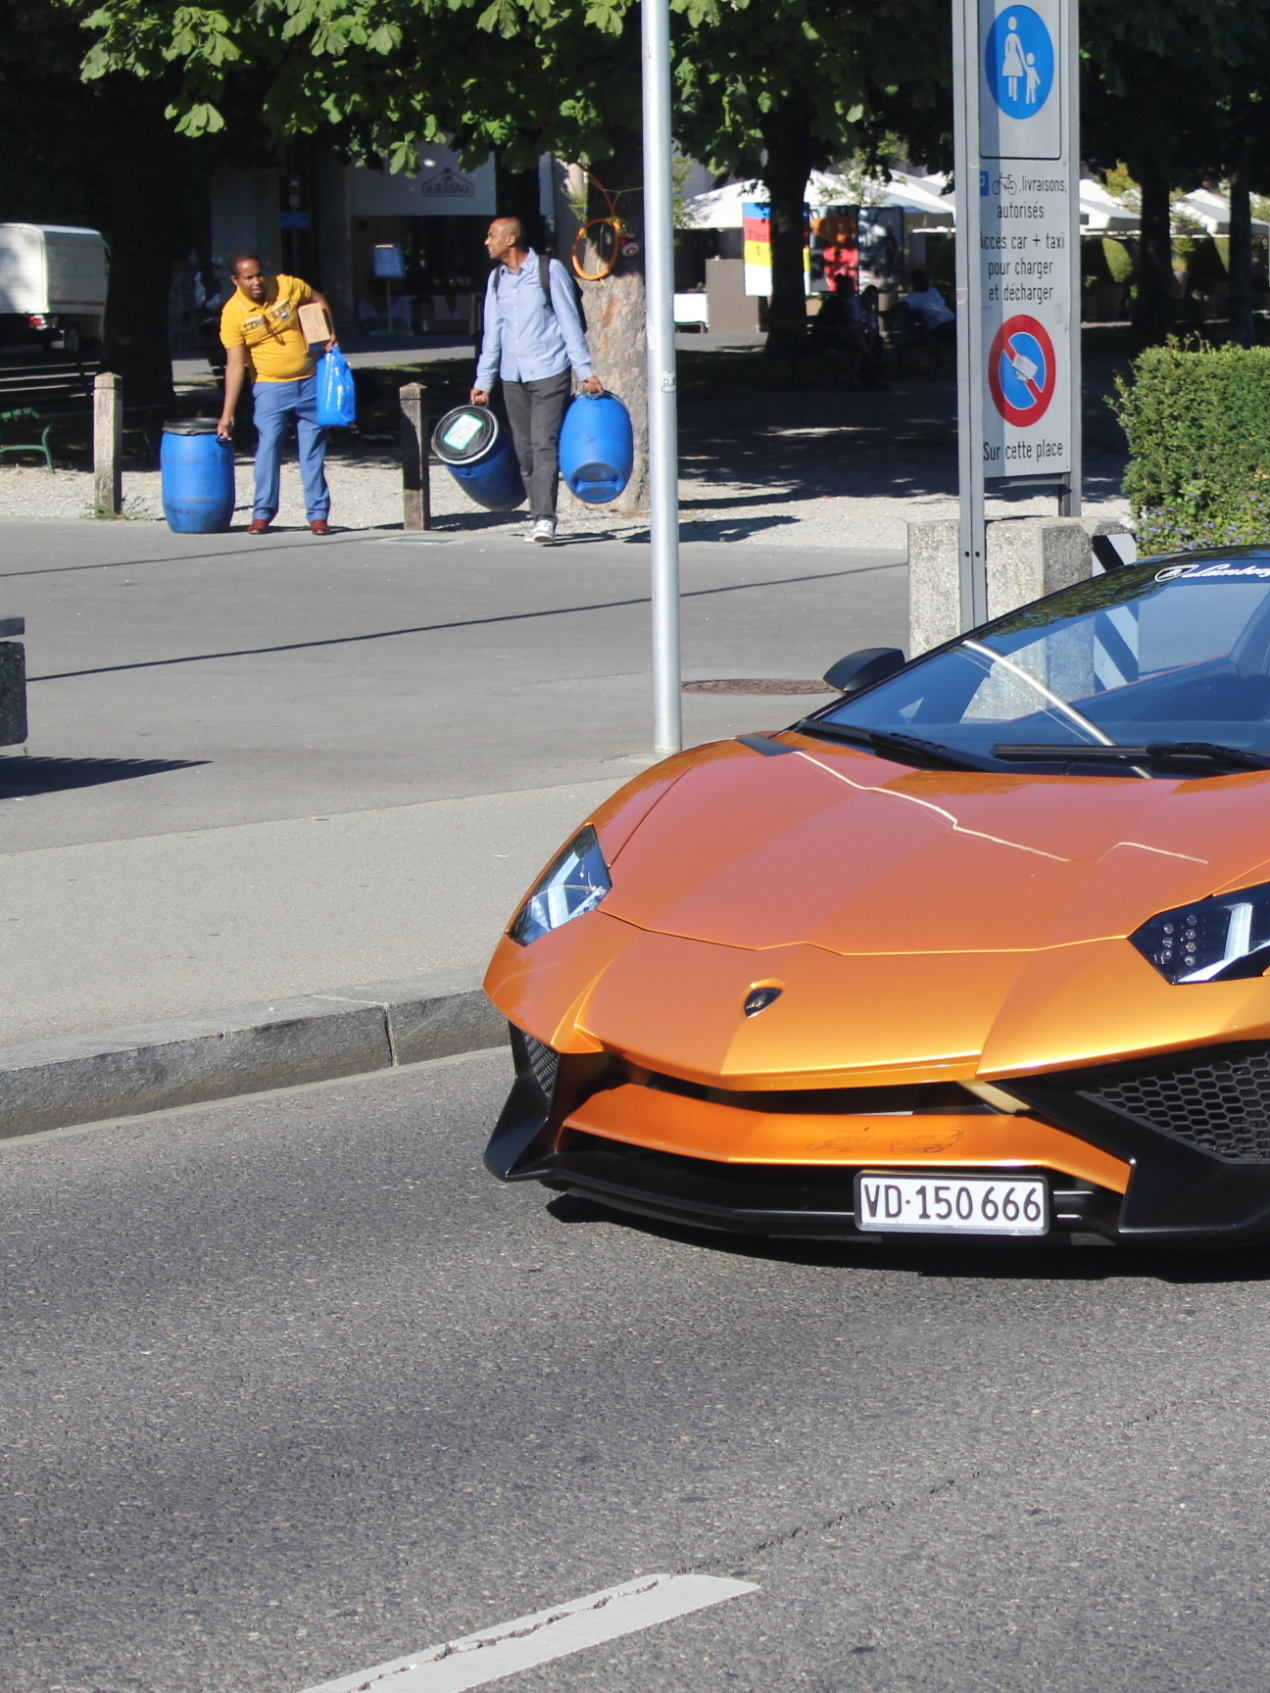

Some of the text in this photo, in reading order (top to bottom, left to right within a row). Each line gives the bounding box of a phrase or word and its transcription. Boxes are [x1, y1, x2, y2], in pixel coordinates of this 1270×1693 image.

[997, 201, 1044, 219] autorisés
[1011, 236, 1027, 249] car
[1033, 233, 1041, 247] +
[1046, 232, 1065, 249] taxi
[988, 257, 1053, 279] pour charger
[989, 282, 1053, 305] et décharger
[983, 438, 1063, 462] Sur cette place
